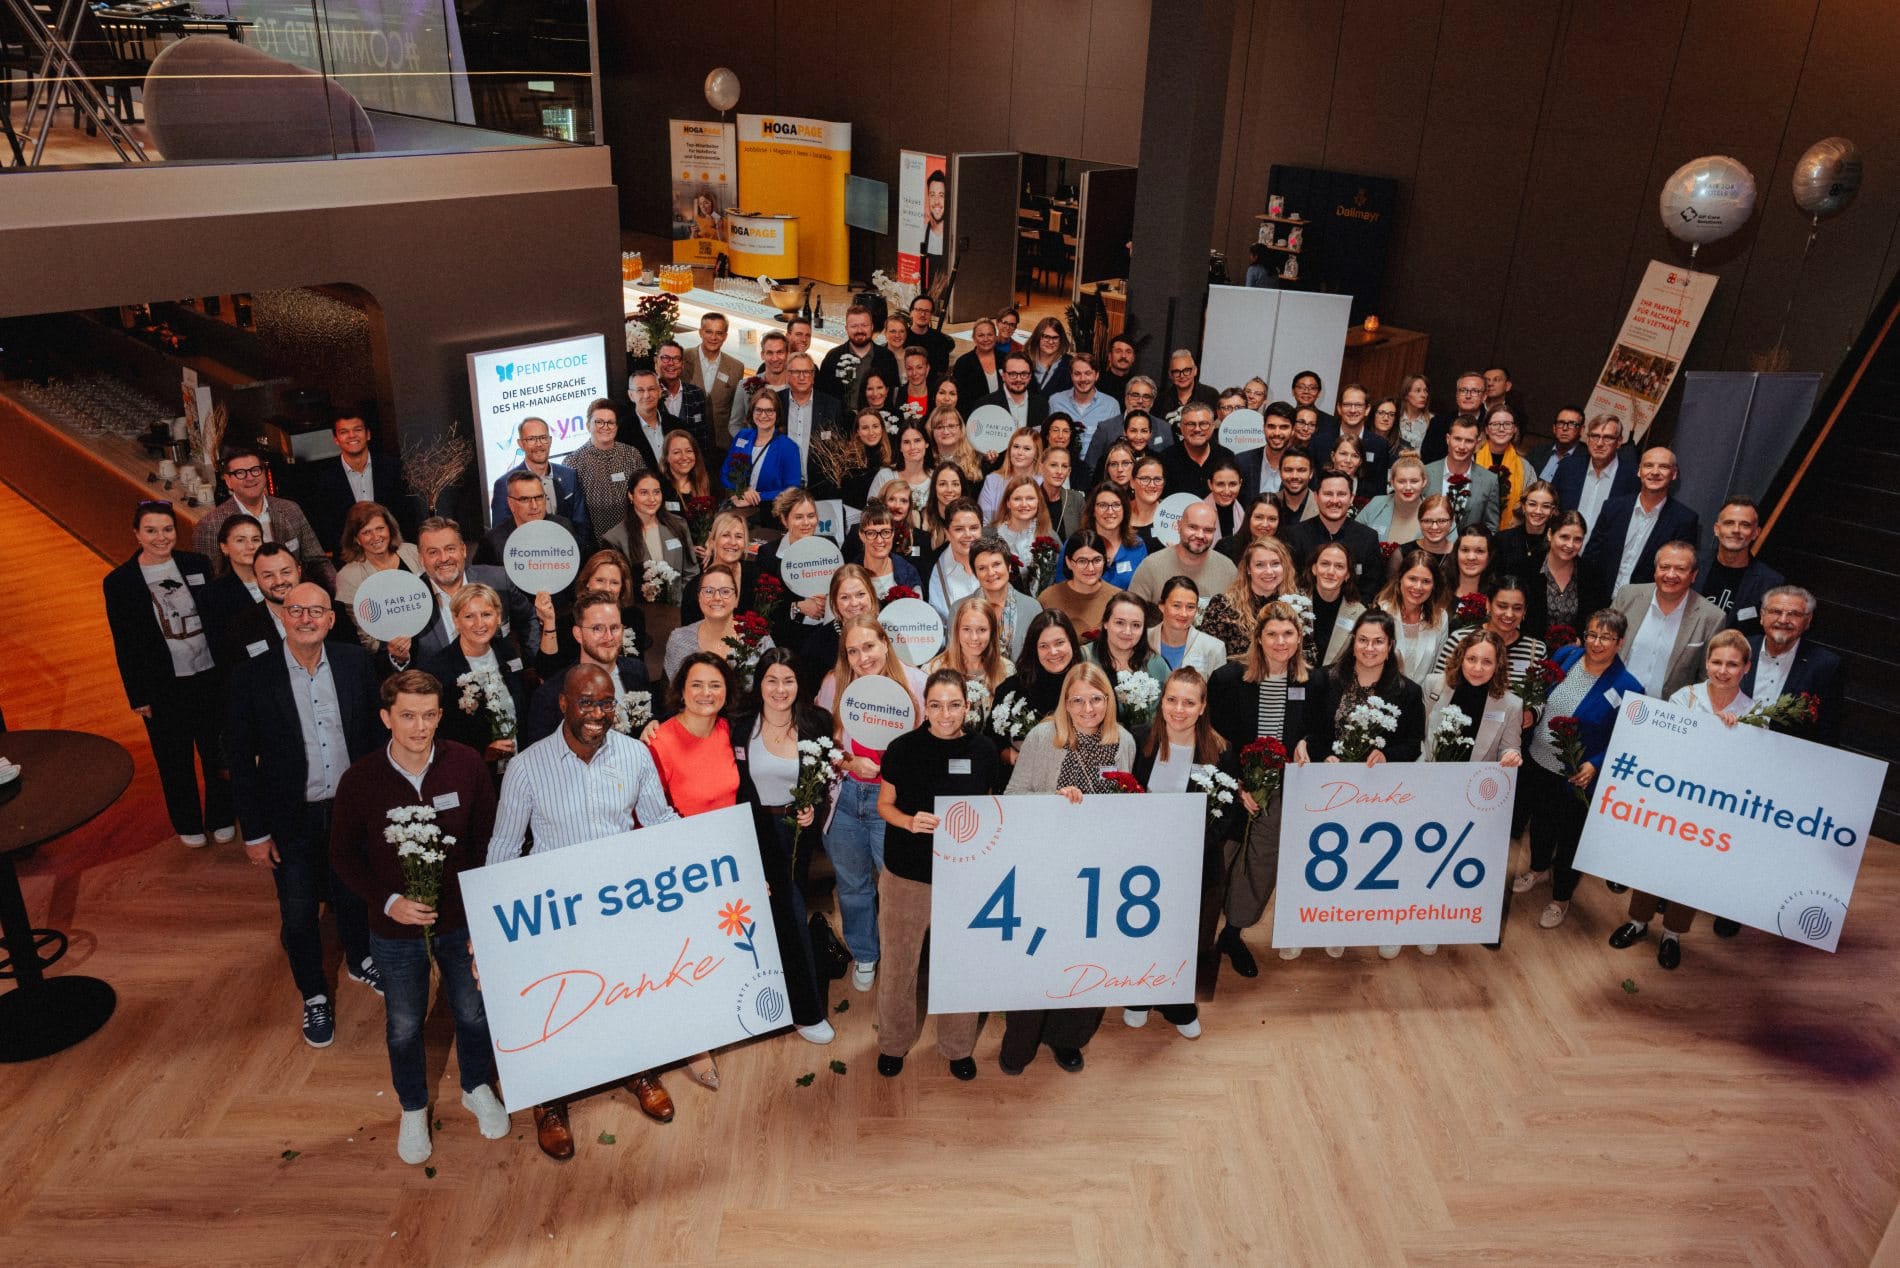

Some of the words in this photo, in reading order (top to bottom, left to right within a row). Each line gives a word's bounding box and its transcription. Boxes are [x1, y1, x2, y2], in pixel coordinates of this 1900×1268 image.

[762, 122, 823, 139] HOGAPAGE
[1336, 205, 1379, 223] Dallmayr
[516, 354, 588, 377] PENTACODE
[502, 389, 518, 400] DIE
[519, 384, 544, 397] NEUE
[545, 376, 586, 392] SPRACHE
[492, 403, 511, 414] DES
[512, 386, 597, 411] HR-MANAGEMENTS
[509, 545, 574, 558] #committed
[785, 554, 840, 570] #committed
[514, 561, 525, 571] to
[528, 559, 571, 570] fairness
[385, 596, 406, 606] FAIR
[409, 592, 427, 602] JOB
[386, 602, 422, 615] HOTELS
[896, 633, 935, 644] fairness
[846, 697, 910, 718] #committed
[849, 711, 860, 721] to
[863, 711, 905, 730] fairness
[1651, 718, 1688, 735] HOTELS
[1654, 709, 1676, 721] FAIR
[1678, 716, 1698, 728] JOB
[1304, 781, 1417, 812] Danke
[1610, 752, 1858, 848] #committedto
[1598, 785, 1733, 853] fairness
[1304, 821, 1486, 892] 82%
[492, 888, 583, 943] Wir
[598, 854, 740, 917] sagen
[1299, 904, 1483, 925] Weiterempfehlung
[1045, 960, 1188, 999] Danke!
[495, 937, 725, 1053] Danke
